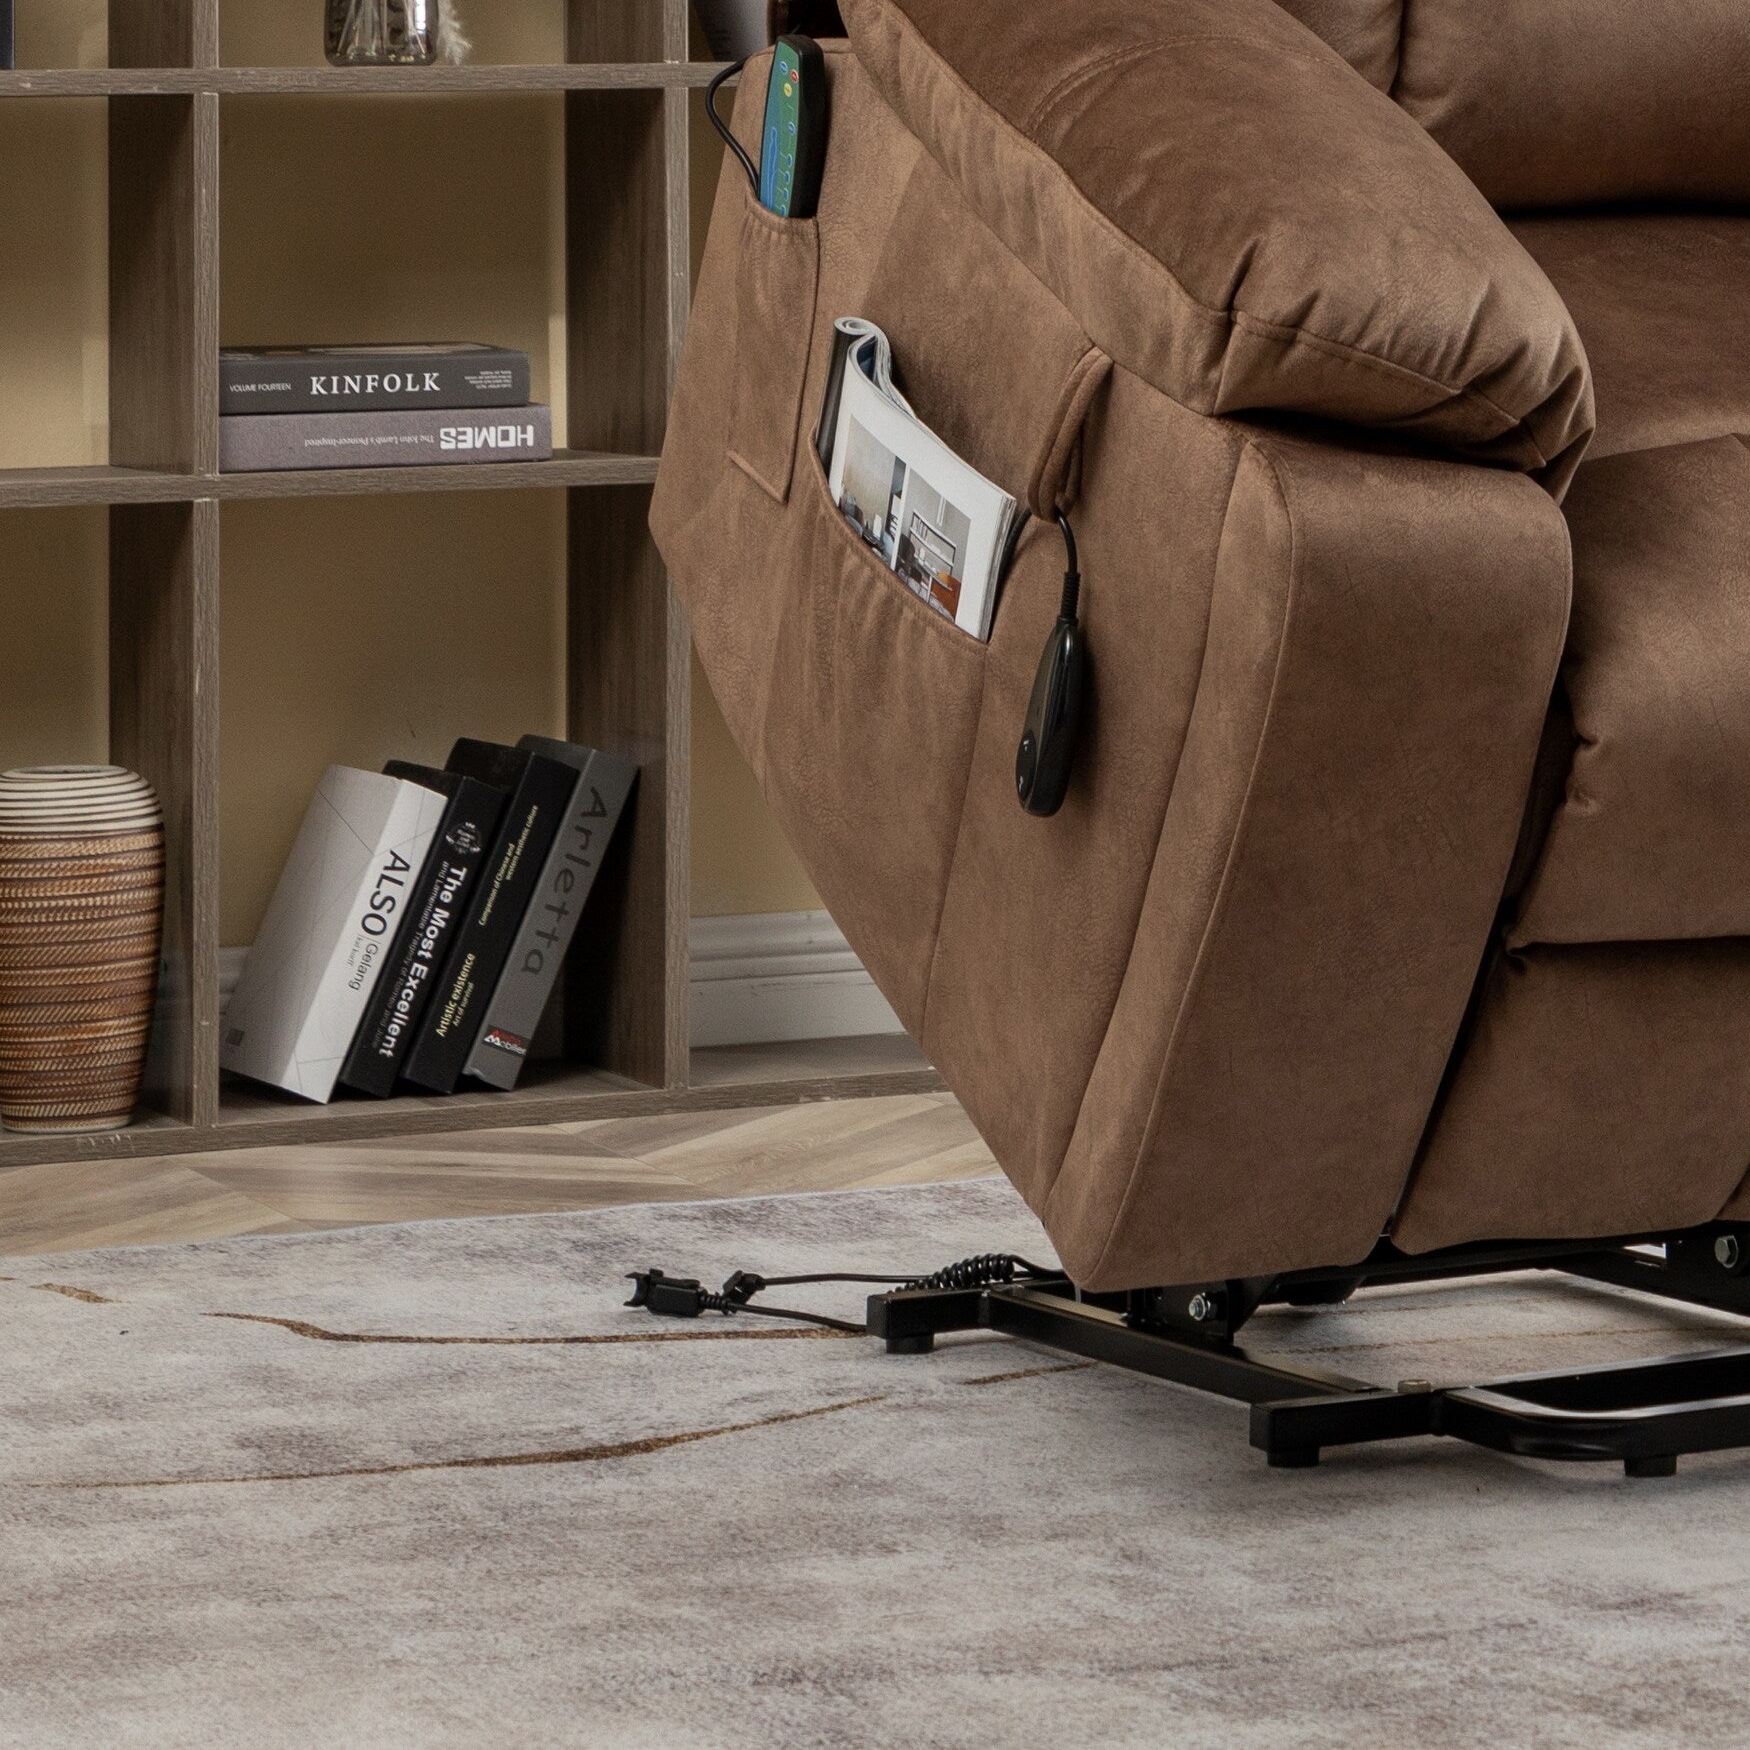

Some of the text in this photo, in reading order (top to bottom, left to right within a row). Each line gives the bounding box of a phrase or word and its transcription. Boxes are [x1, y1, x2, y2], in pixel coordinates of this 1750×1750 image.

[310, 372, 440, 396] KINFOLK
[440, 425, 534, 449] HOMES
[361, 850, 411, 936] ALSO
[440, 866, 468, 903] The
[521, 785, 609, 976] Arletta
[417, 907, 450, 959] Most
[349, 943, 379, 991] Gelang
[379, 962, 429, 1058] Excellent
[435, 953, 476, 1038] Artistic existence
